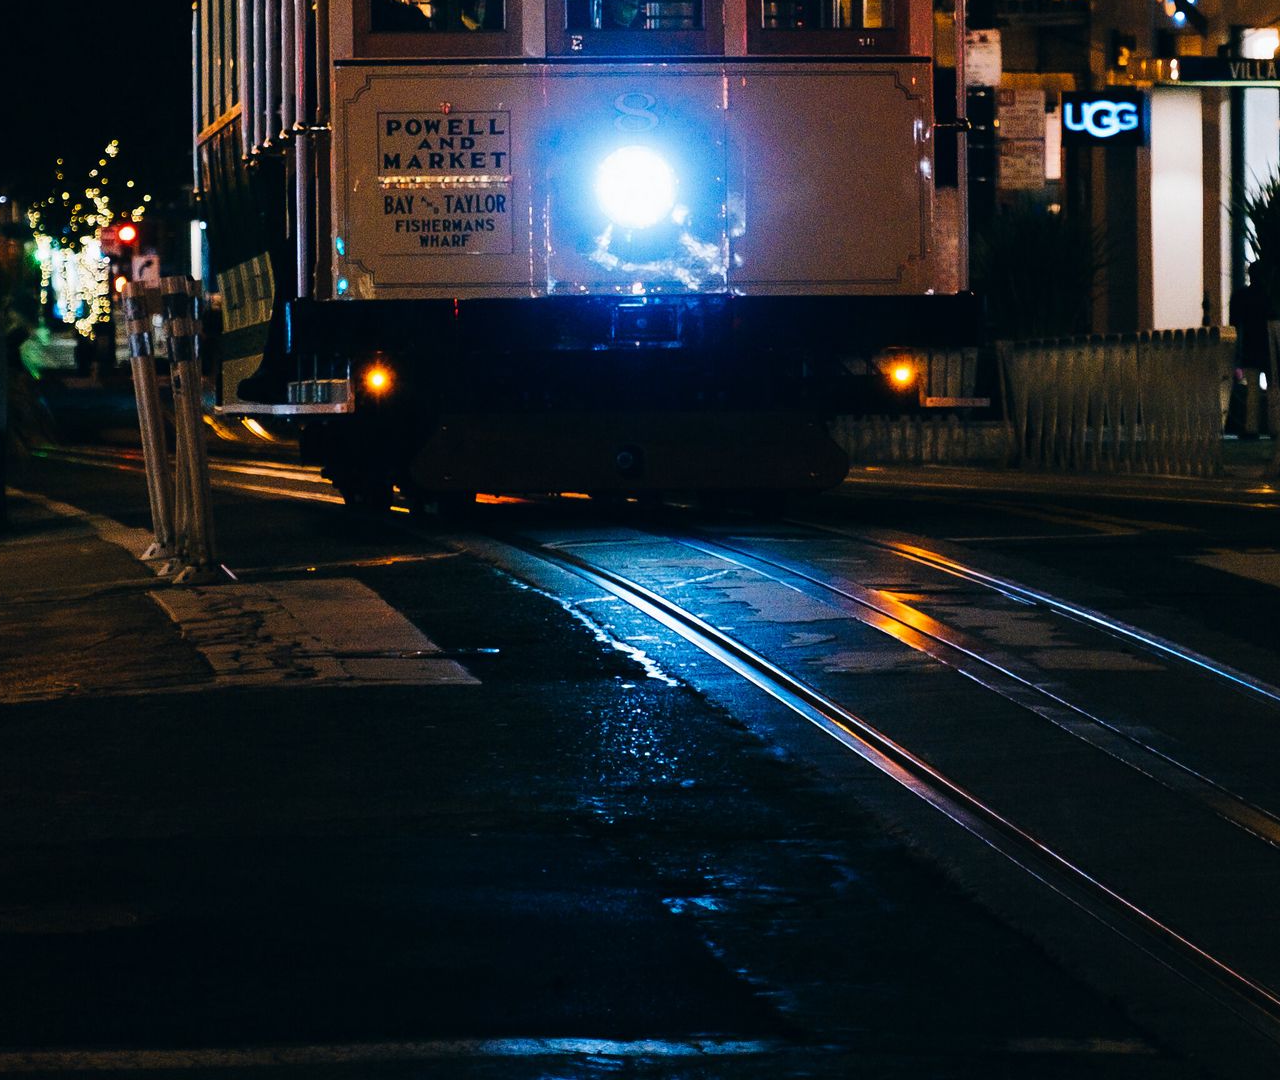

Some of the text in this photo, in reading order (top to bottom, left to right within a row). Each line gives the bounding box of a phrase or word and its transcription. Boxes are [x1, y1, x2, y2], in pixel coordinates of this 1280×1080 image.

[1230, 62, 1277, 80] VILLA
[1064, 99, 1139, 138] UGG
[386, 119, 505, 136] POWELL
[418, 137, 475, 150] AND
[384, 152, 506, 169] MARKET
[384, 195, 414, 215] BAY
[444, 194, 506, 214] TAYLOR
[395, 219, 495, 233] FISHERMANS
[420, 234, 471, 248] WHARF
